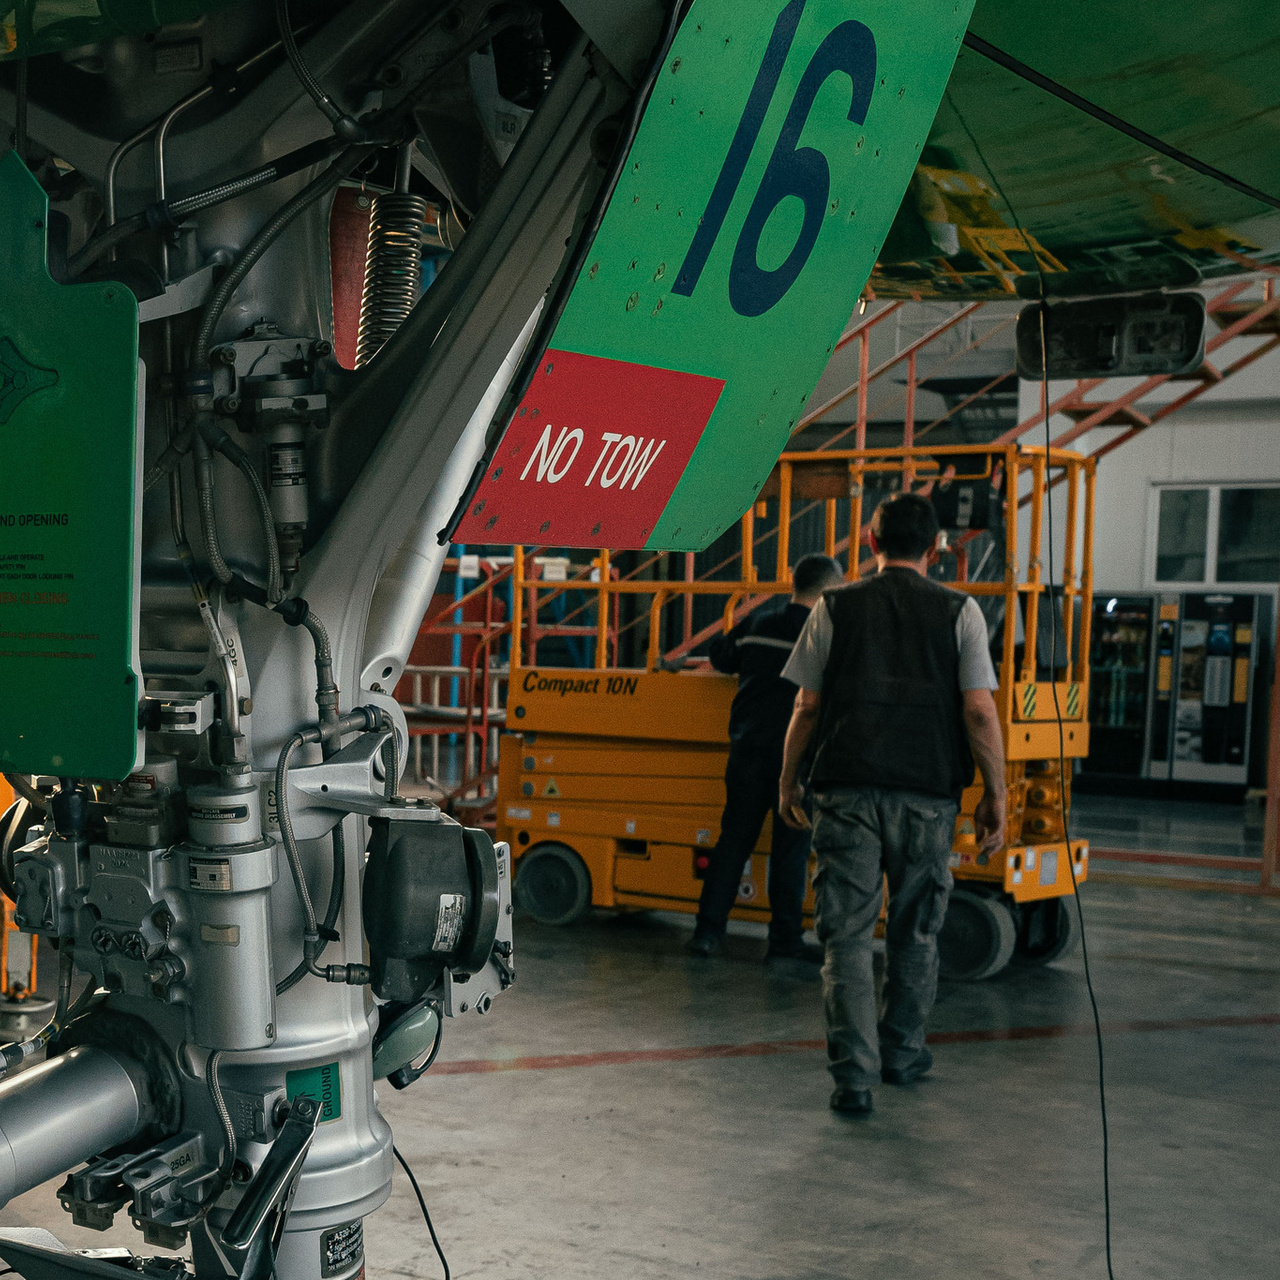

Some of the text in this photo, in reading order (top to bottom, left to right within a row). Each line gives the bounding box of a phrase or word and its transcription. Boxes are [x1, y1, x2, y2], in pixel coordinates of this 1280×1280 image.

[520, 423, 671, 492] NO TOW
[18, 513, 69, 527] OPENING
[20, 592, 69, 605] CLOSING
[227, 638, 238, 666] 4GC
[523, 671, 639, 697] Compact 10N
[321, 1067, 333, 1117] GROUND
[170, 1153, 191, 1171] 25GA
